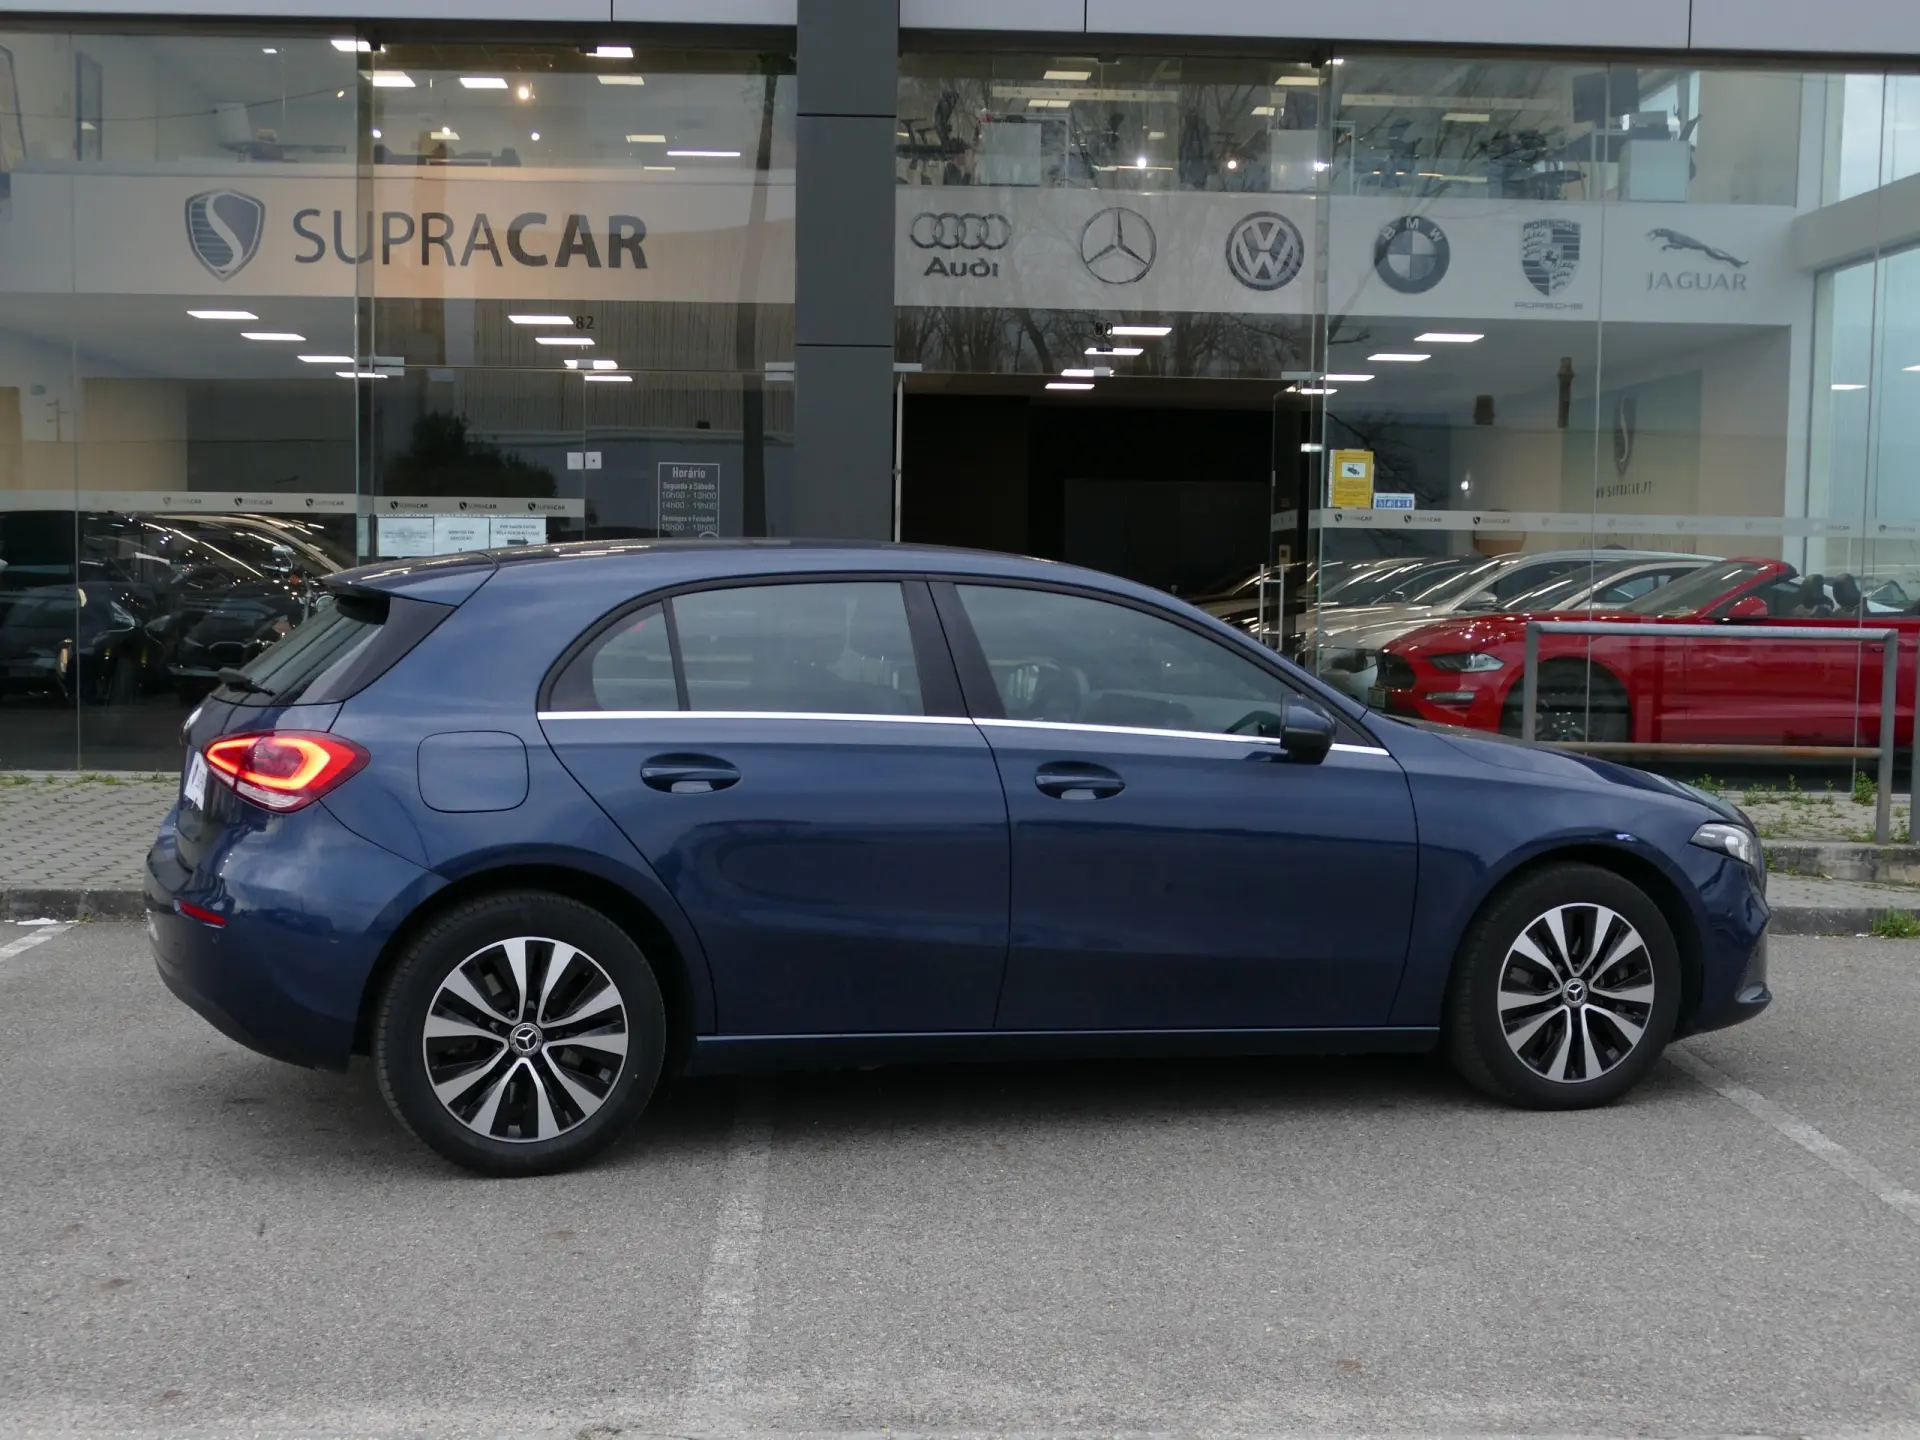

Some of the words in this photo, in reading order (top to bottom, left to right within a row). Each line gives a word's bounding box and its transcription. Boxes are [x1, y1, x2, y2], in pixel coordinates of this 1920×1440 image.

[293, 208, 648, 269] SUPRACAR
[1381, 217, 1443, 243] BMW
[923, 256, 999, 277] Audi
[1646, 270, 1748, 292] JAGUAR
[1514, 301, 1583, 310] PORSCHE
[575, 315, 595, 330] 82
[672, 466, 706, 479] Horário
